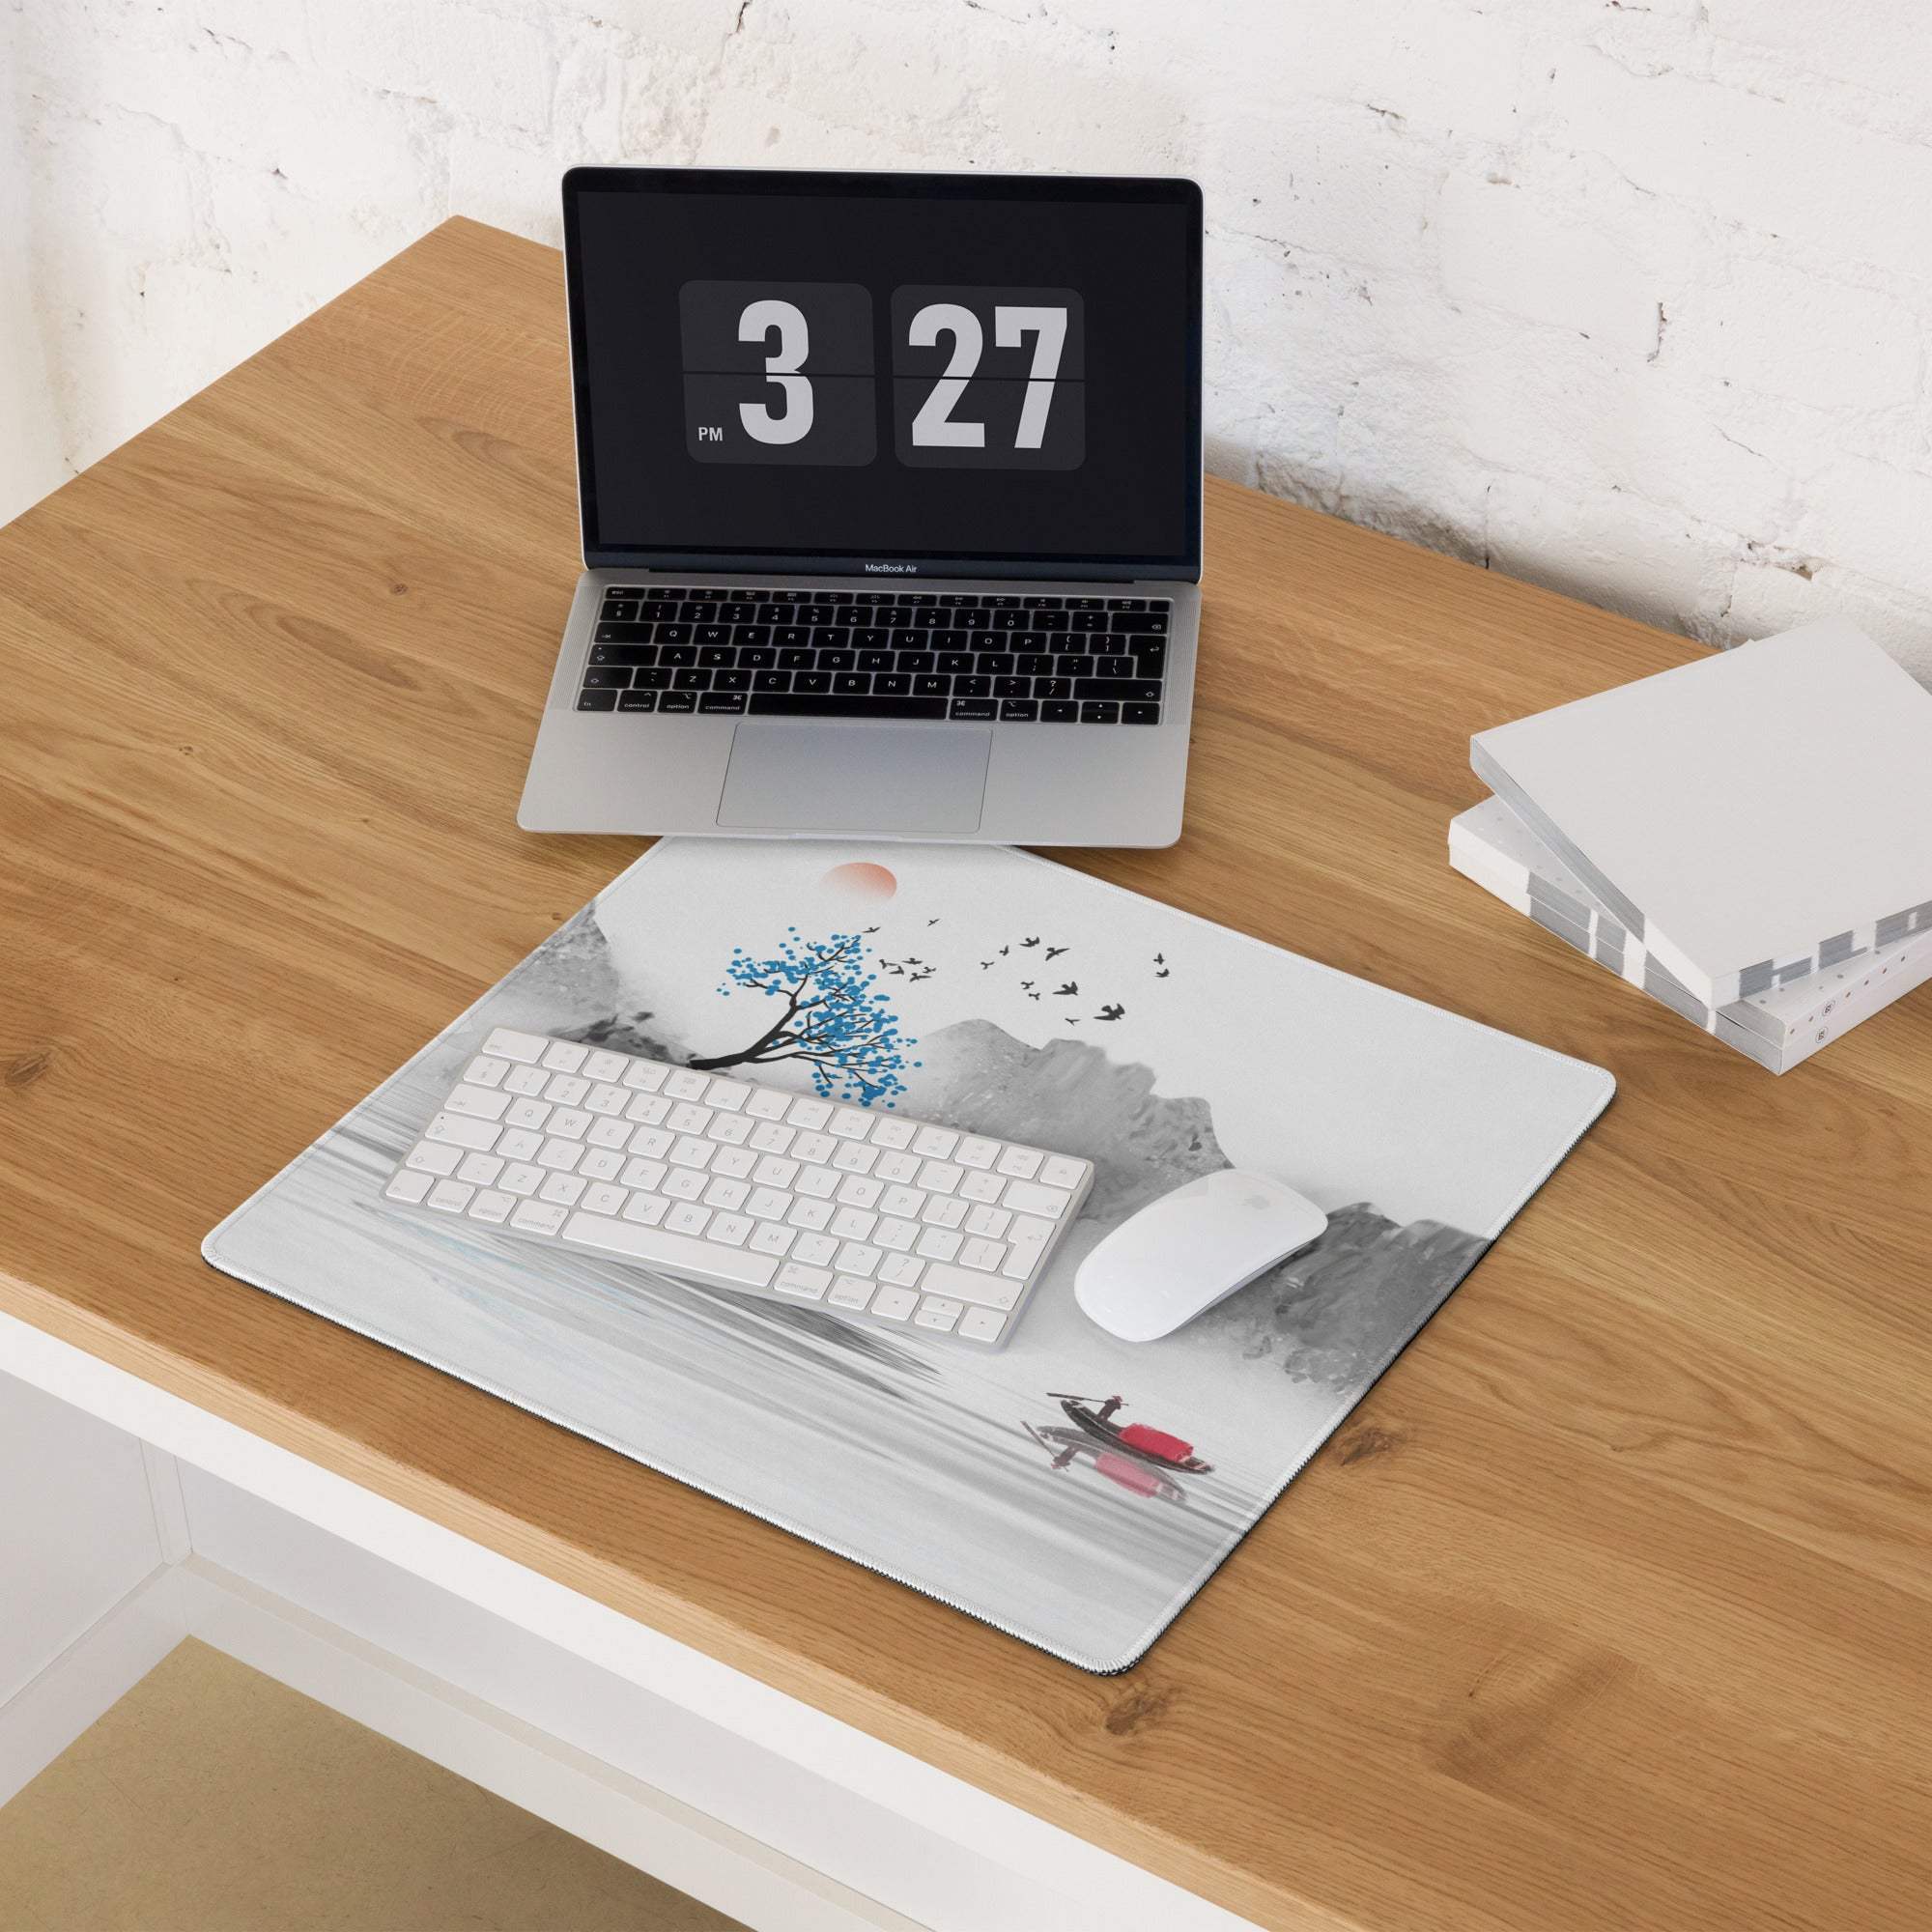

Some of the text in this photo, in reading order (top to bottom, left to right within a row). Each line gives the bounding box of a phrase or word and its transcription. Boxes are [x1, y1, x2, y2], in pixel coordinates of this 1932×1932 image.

[738, 299, 1067, 449] 3 27
[698, 426, 723, 441] PM
[865, 564, 904, 572] MacBook
